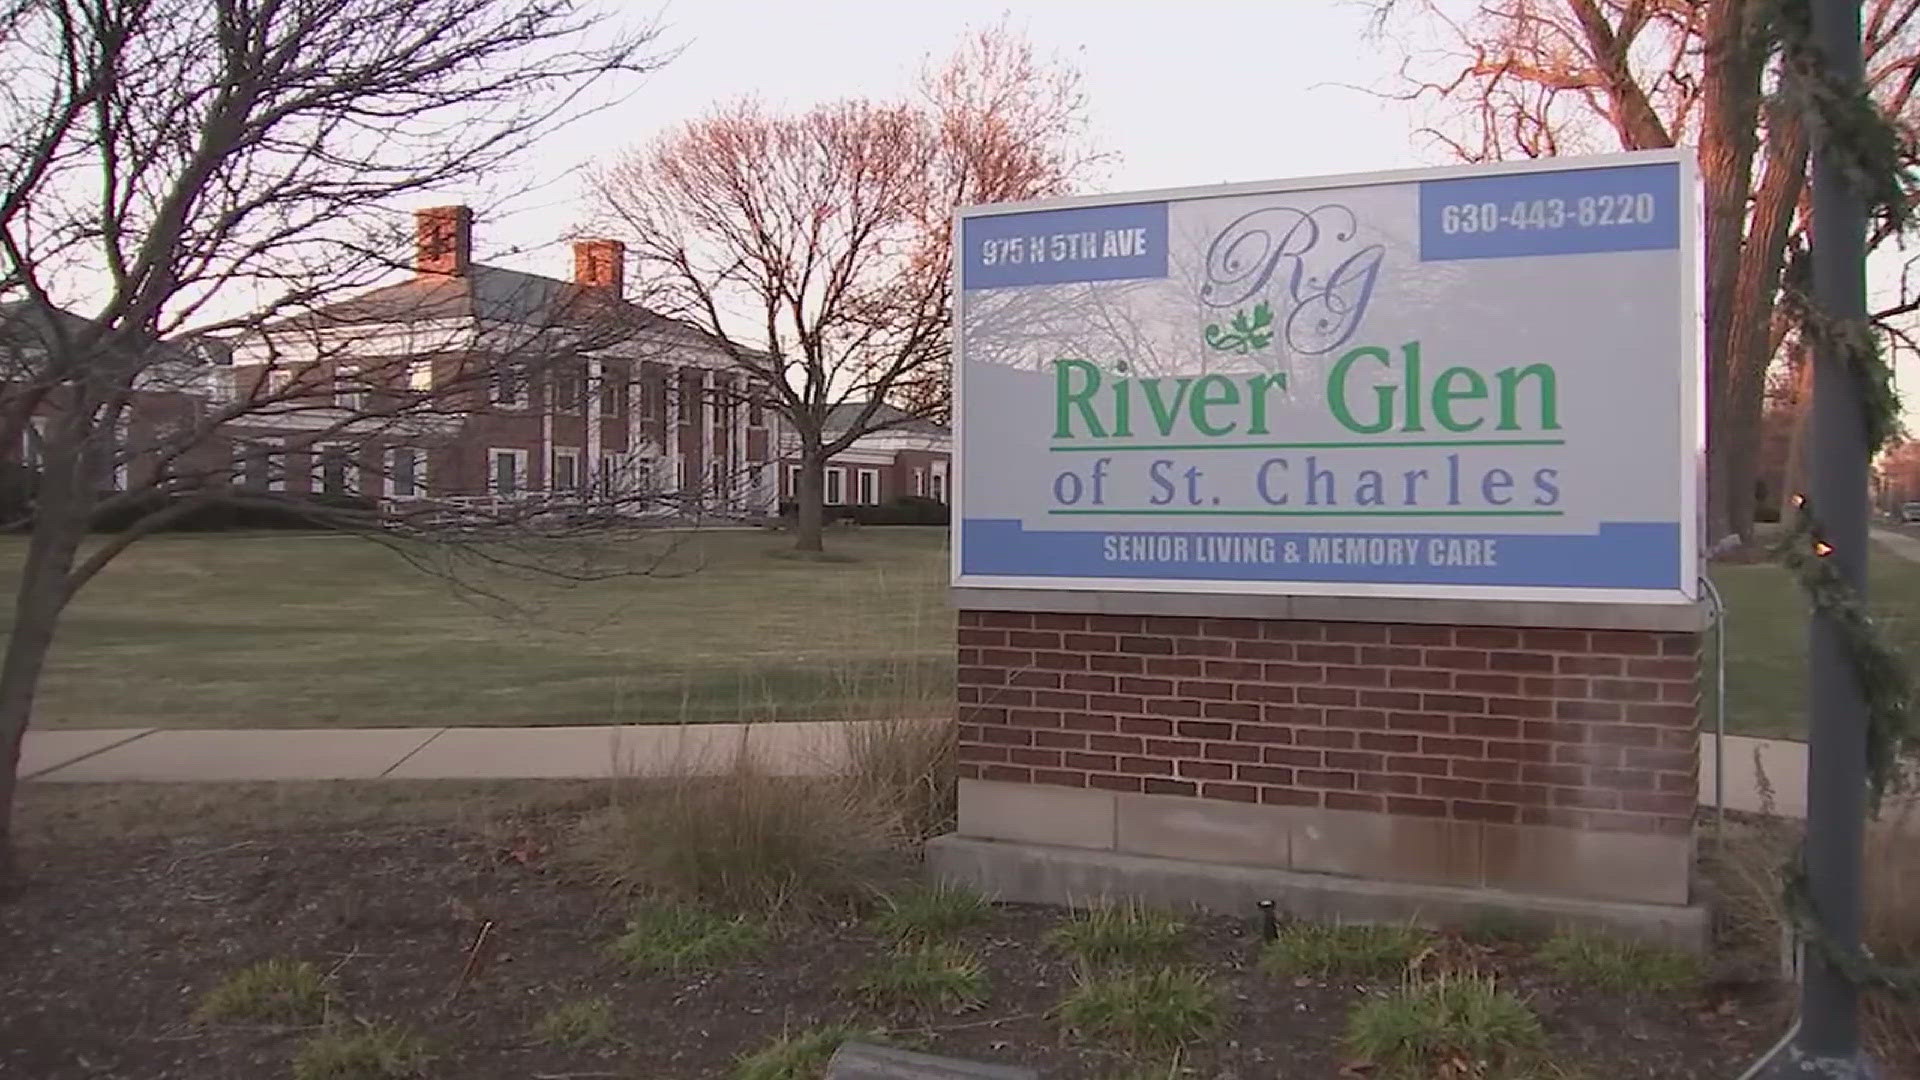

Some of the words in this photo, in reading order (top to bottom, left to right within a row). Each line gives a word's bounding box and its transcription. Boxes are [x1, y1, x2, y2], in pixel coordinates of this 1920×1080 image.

[1441, 192, 1655, 236] 630-443-8220
[982, 238, 1024, 266] 975
[1029, 236, 1047, 264] N
[1051, 232, 1096, 261] 5TH
[1101, 228, 1147, 258] AVE
[1054, 358, 1288, 438] River
[1327, 341, 1562, 434] Glen
[1054, 457, 1111, 506] of
[1150, 459, 1220, 506] St.
[1257, 453, 1561, 506] Charles
[1103, 536, 1188, 562] SENIOR
[1196, 537, 1277, 564] LIVING
[1284, 543, 1300, 564] &
[1308, 538, 1421, 565] MEMORY
[1428, 539, 1498, 567] CARE
